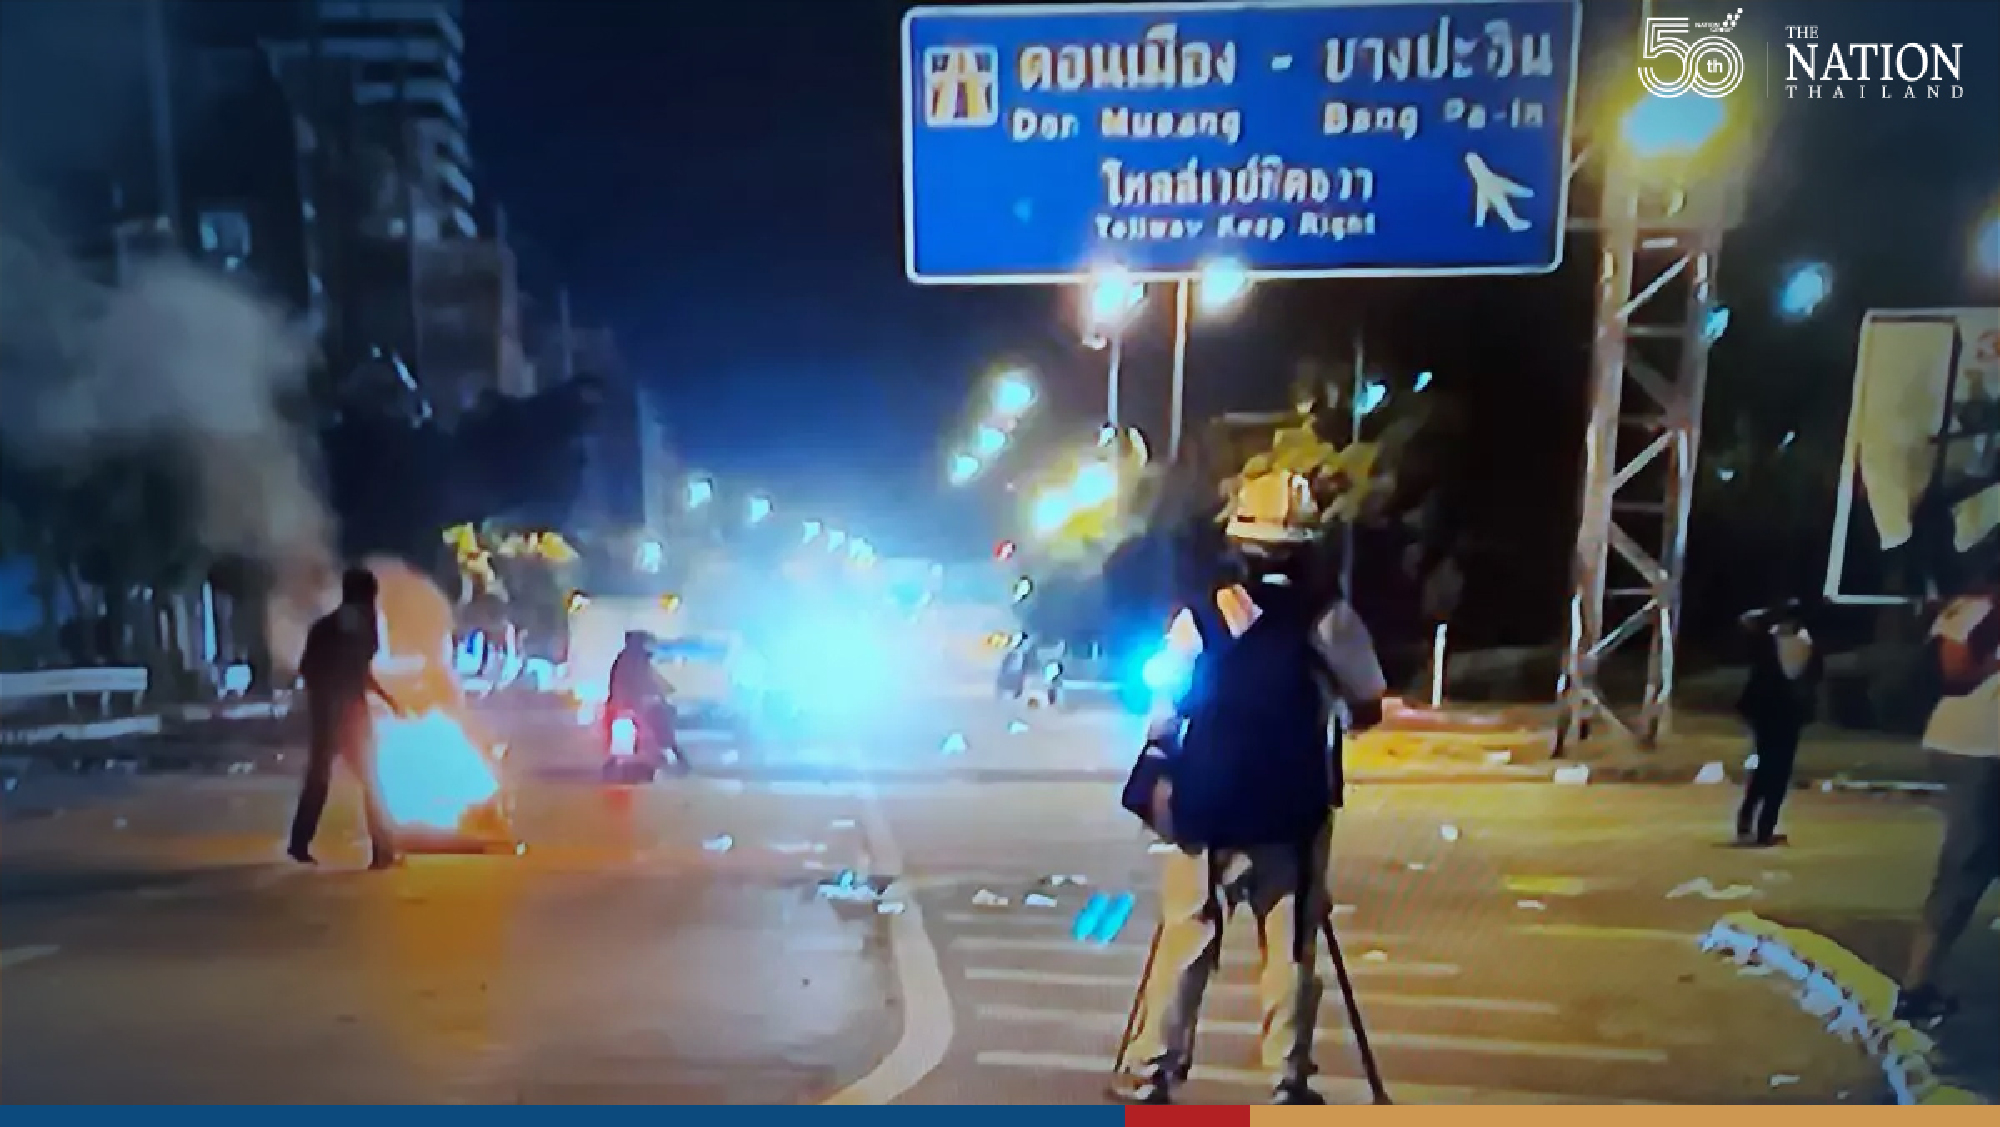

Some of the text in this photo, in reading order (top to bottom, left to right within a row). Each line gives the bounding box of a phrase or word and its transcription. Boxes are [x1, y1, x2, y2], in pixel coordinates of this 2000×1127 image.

[1019, 23, 1237, 91] ดอนเมือง
[1325, 15, 1553, 83] บางปะอิน
[1011, 106, 1080, 142] Don
[1323, 101, 1419, 141] Bang
